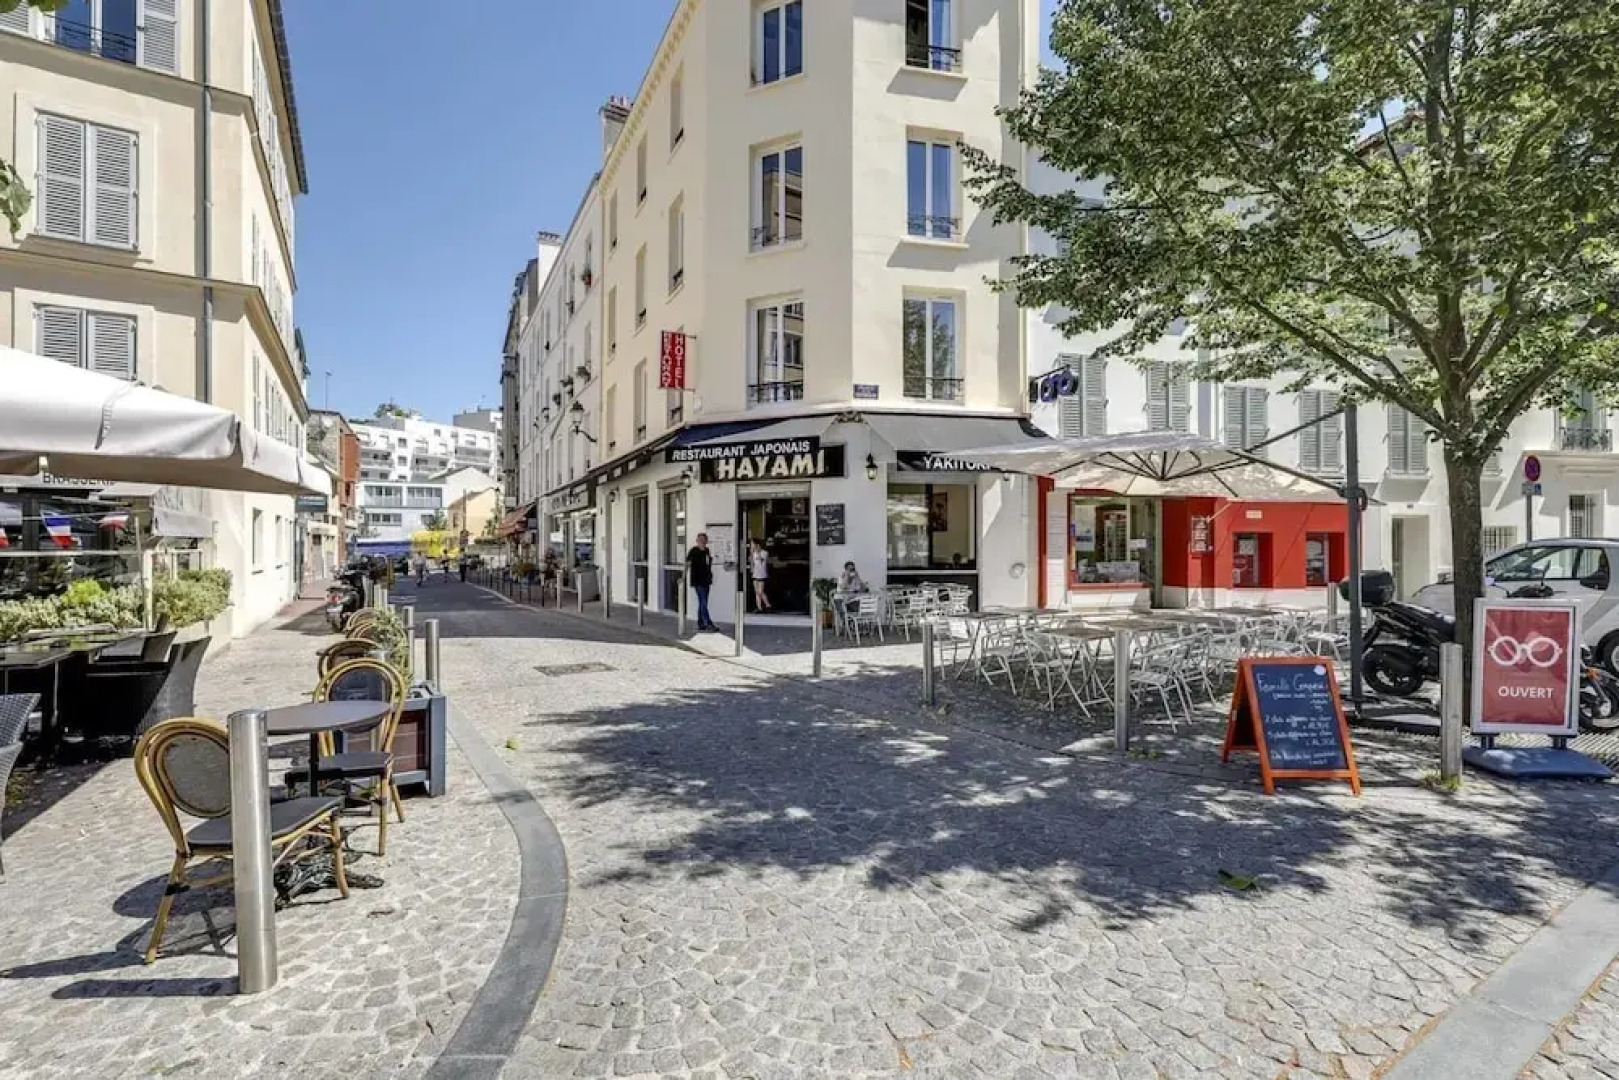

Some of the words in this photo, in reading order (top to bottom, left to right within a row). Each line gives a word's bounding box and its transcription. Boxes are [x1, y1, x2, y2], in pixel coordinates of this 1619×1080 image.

[675, 334, 684, 389] HOTEL
[672, 445, 746, 461] RESTAURANT
[750, 440, 811, 456] JAPONAIS
[717, 450, 825, 480] HAYAMI
[1497, 685, 1555, 699] OUVERT
